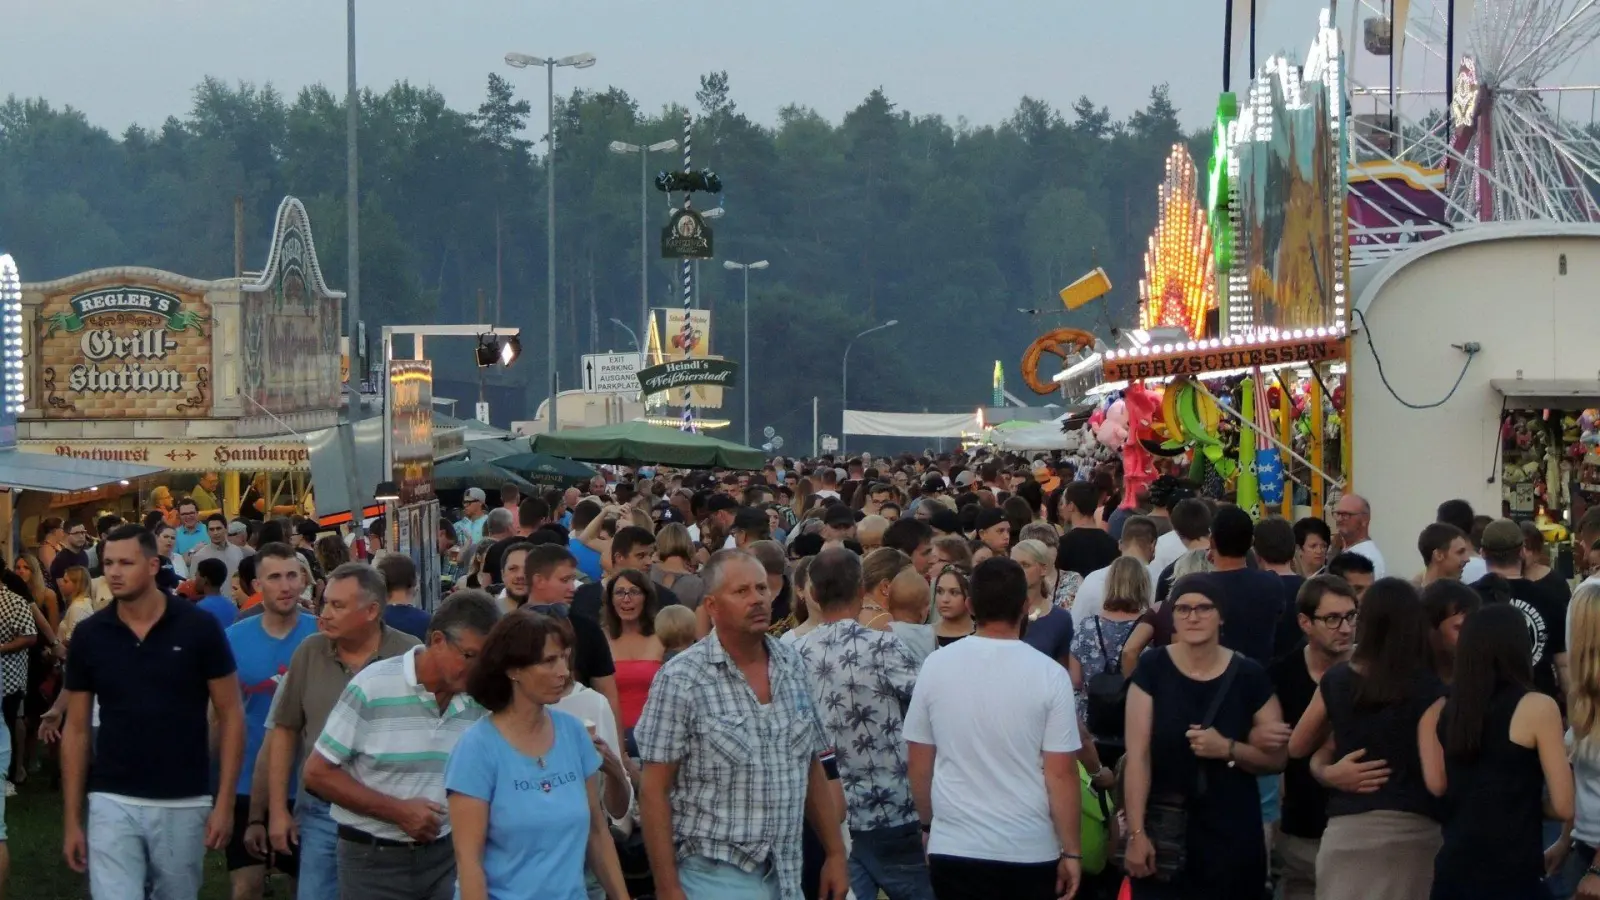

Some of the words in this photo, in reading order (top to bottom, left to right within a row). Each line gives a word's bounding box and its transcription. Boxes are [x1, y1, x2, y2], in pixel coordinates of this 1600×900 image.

[80, 328, 178, 362] Grill-
[609, 356, 625, 364] EXIT
[1116, 341, 1327, 379] HERZSCHIESSEN
[601, 364, 634, 372] PARKING
[600, 374, 636, 382] AUSGANG
[597, 382, 640, 390] PARKPLATZ
